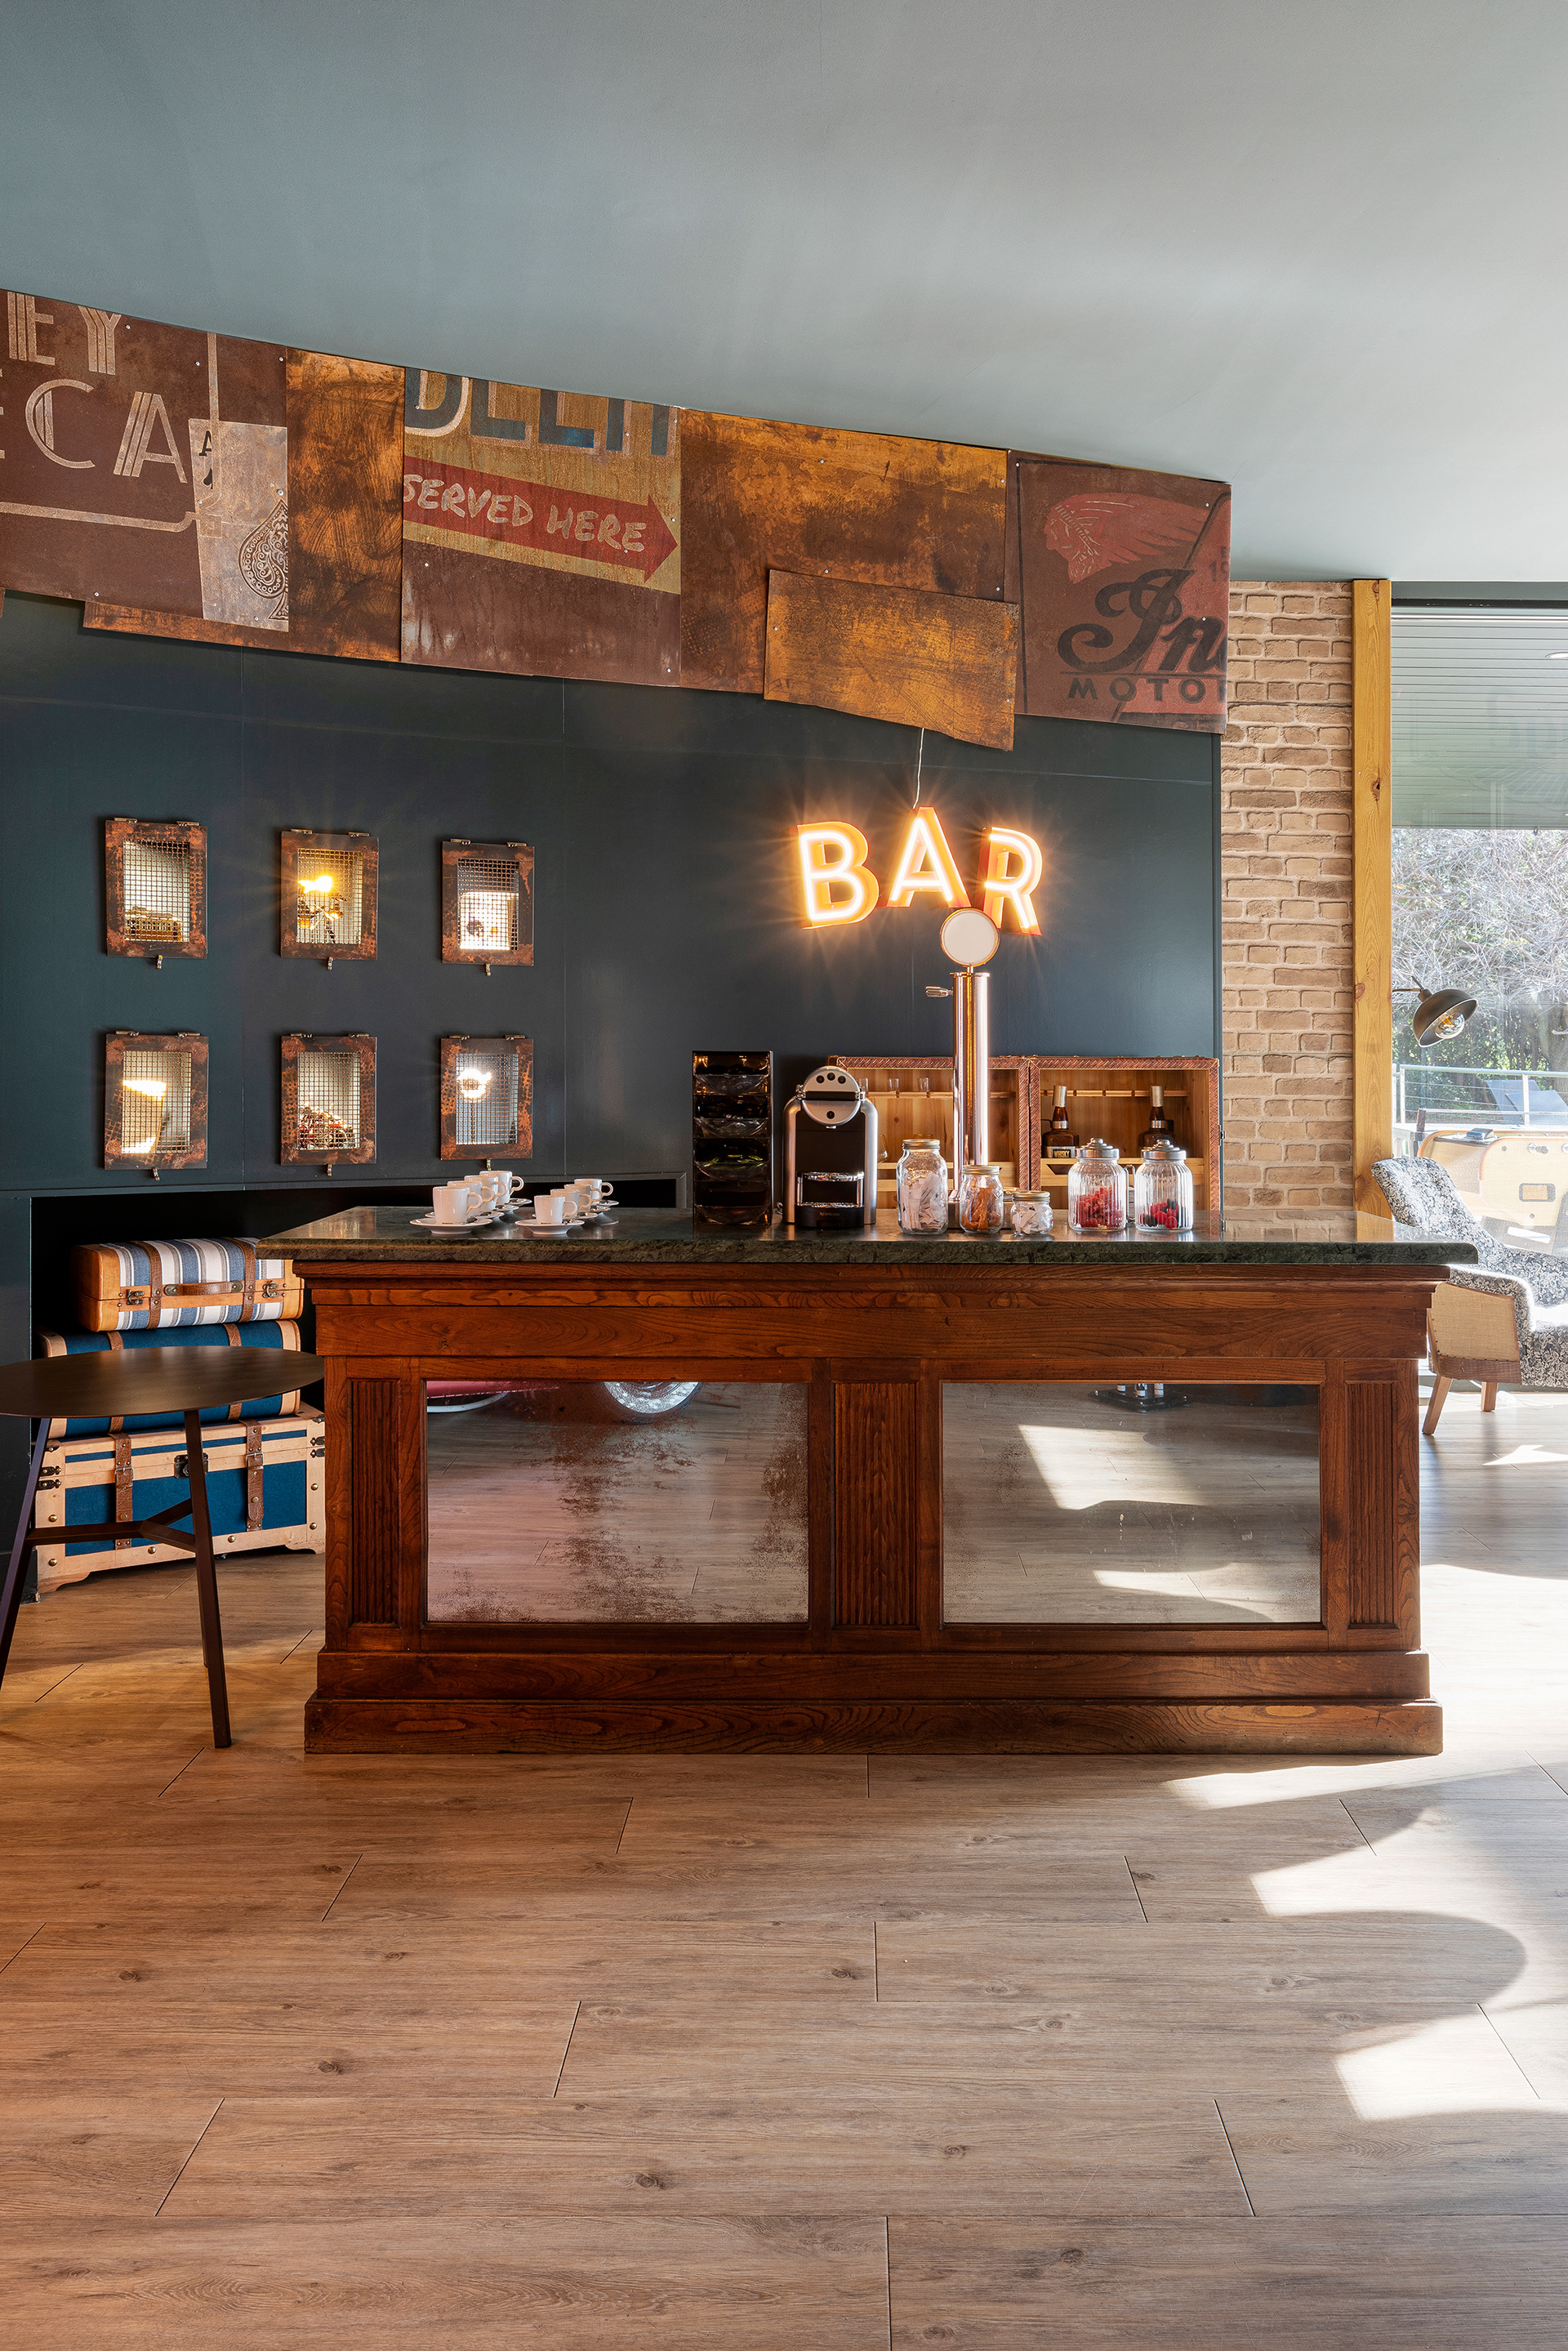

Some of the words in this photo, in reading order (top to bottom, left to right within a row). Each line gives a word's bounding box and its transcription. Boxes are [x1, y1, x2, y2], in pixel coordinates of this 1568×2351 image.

[403, 474, 533, 527] SERVED
[546, 505, 647, 553] HERE
[789, 806, 1041, 935] BAR
[1054, 1150, 1070, 1158] WHISKY
